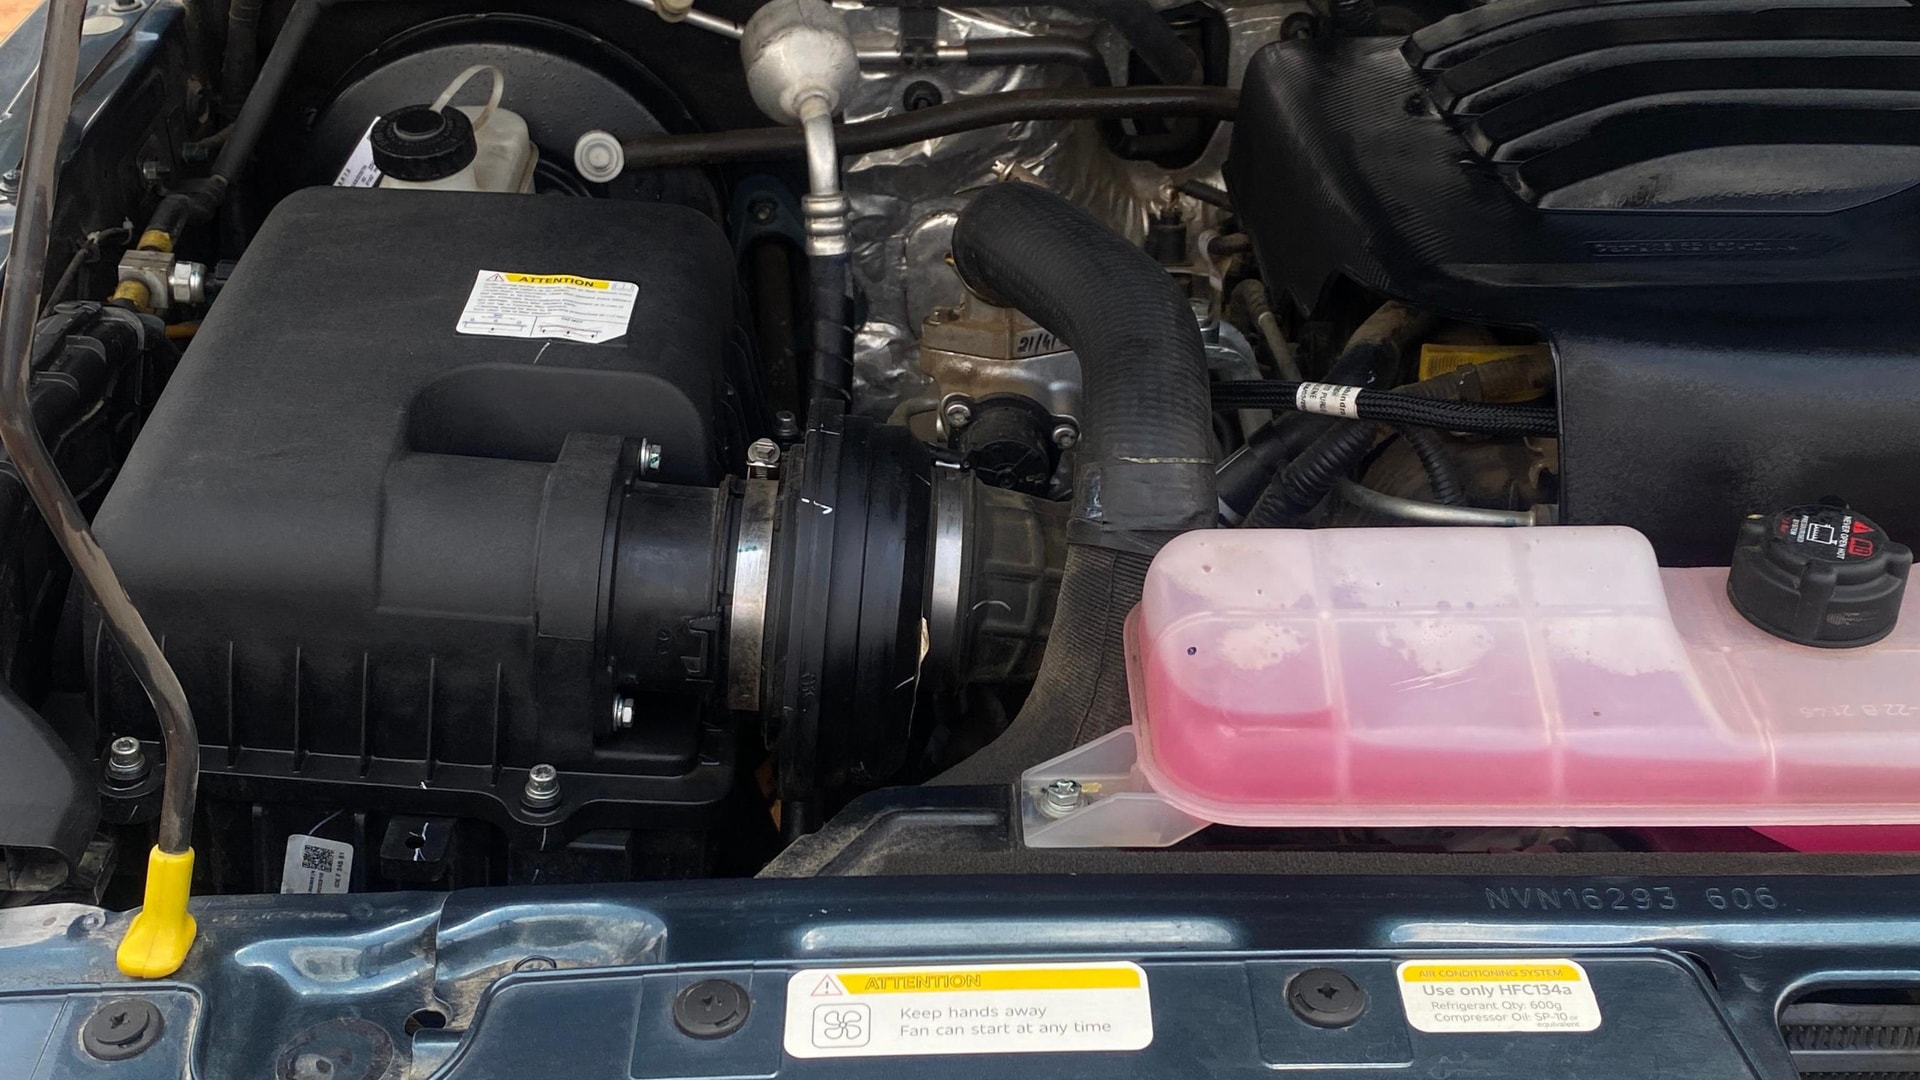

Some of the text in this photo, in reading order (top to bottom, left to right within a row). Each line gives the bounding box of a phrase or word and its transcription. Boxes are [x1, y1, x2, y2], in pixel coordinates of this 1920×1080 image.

[519, 276, 594, 287] ATTENTION
[1836, 515, 1852, 560] NEVER OPEN HOT
[1484, 886, 1779, 911] NVN16293 606
[1419, 969, 1563, 978] AIR CONDITIONING SYSTEM
[864, 974, 981, 991] ATTENTION
[1422, 983, 1573, 999] Use only HFC134a
[900, 1005, 1047, 1021] Keep hands away
[1430, 1000, 1500, 1012] Refrigerant
[1530, 1000, 1563, 1012] 600g
[1434, 1012, 1508, 1023] Compressor
[1511, 1012, 1531, 1022] Oil:
[1534, 1012, 1569, 1022] SP-10
[900, 1020, 1112, 1037] Fan can start at any time
